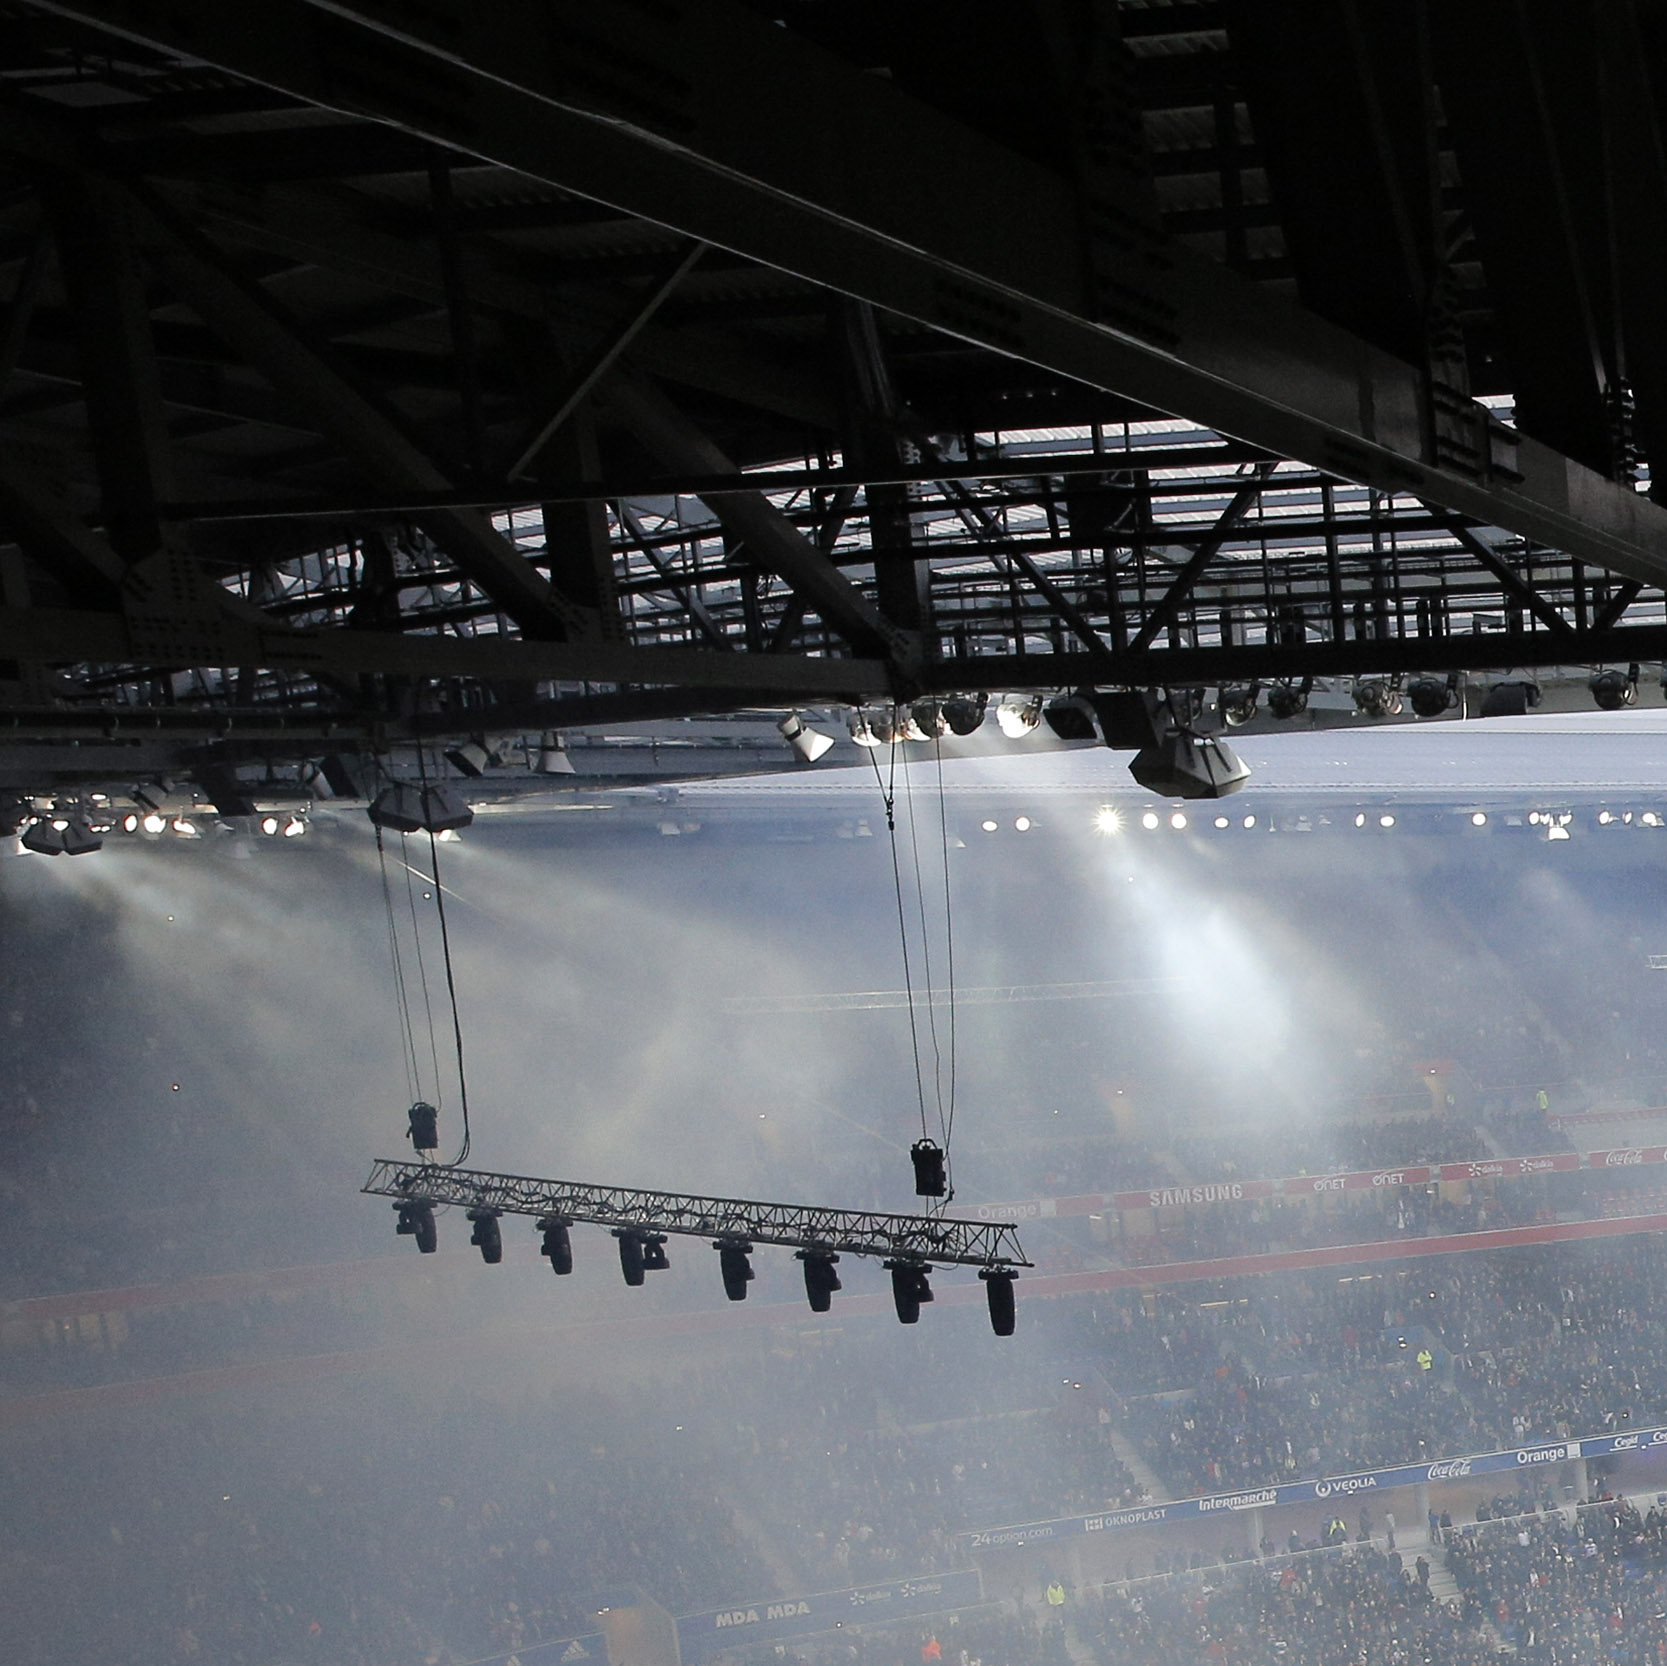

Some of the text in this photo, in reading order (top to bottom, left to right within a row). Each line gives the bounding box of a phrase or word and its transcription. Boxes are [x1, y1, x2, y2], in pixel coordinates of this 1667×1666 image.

[1150, 1184, 1243, 1207] SAMSUNG
[978, 1203, 1037, 1220] Orange
[1614, 1435, 1638, 1449] Cegid
[1517, 1447, 1565, 1465] Orange
[1427, 1459, 1471, 1480] Coca-Cola
[1333, 1476, 1377, 1491] VEOLIA
[1199, 1488, 1278, 1510] Intermarché
[1105, 1508, 1167, 1527] OKNOPLAST
[716, 1602, 811, 1628] MDA MDA
